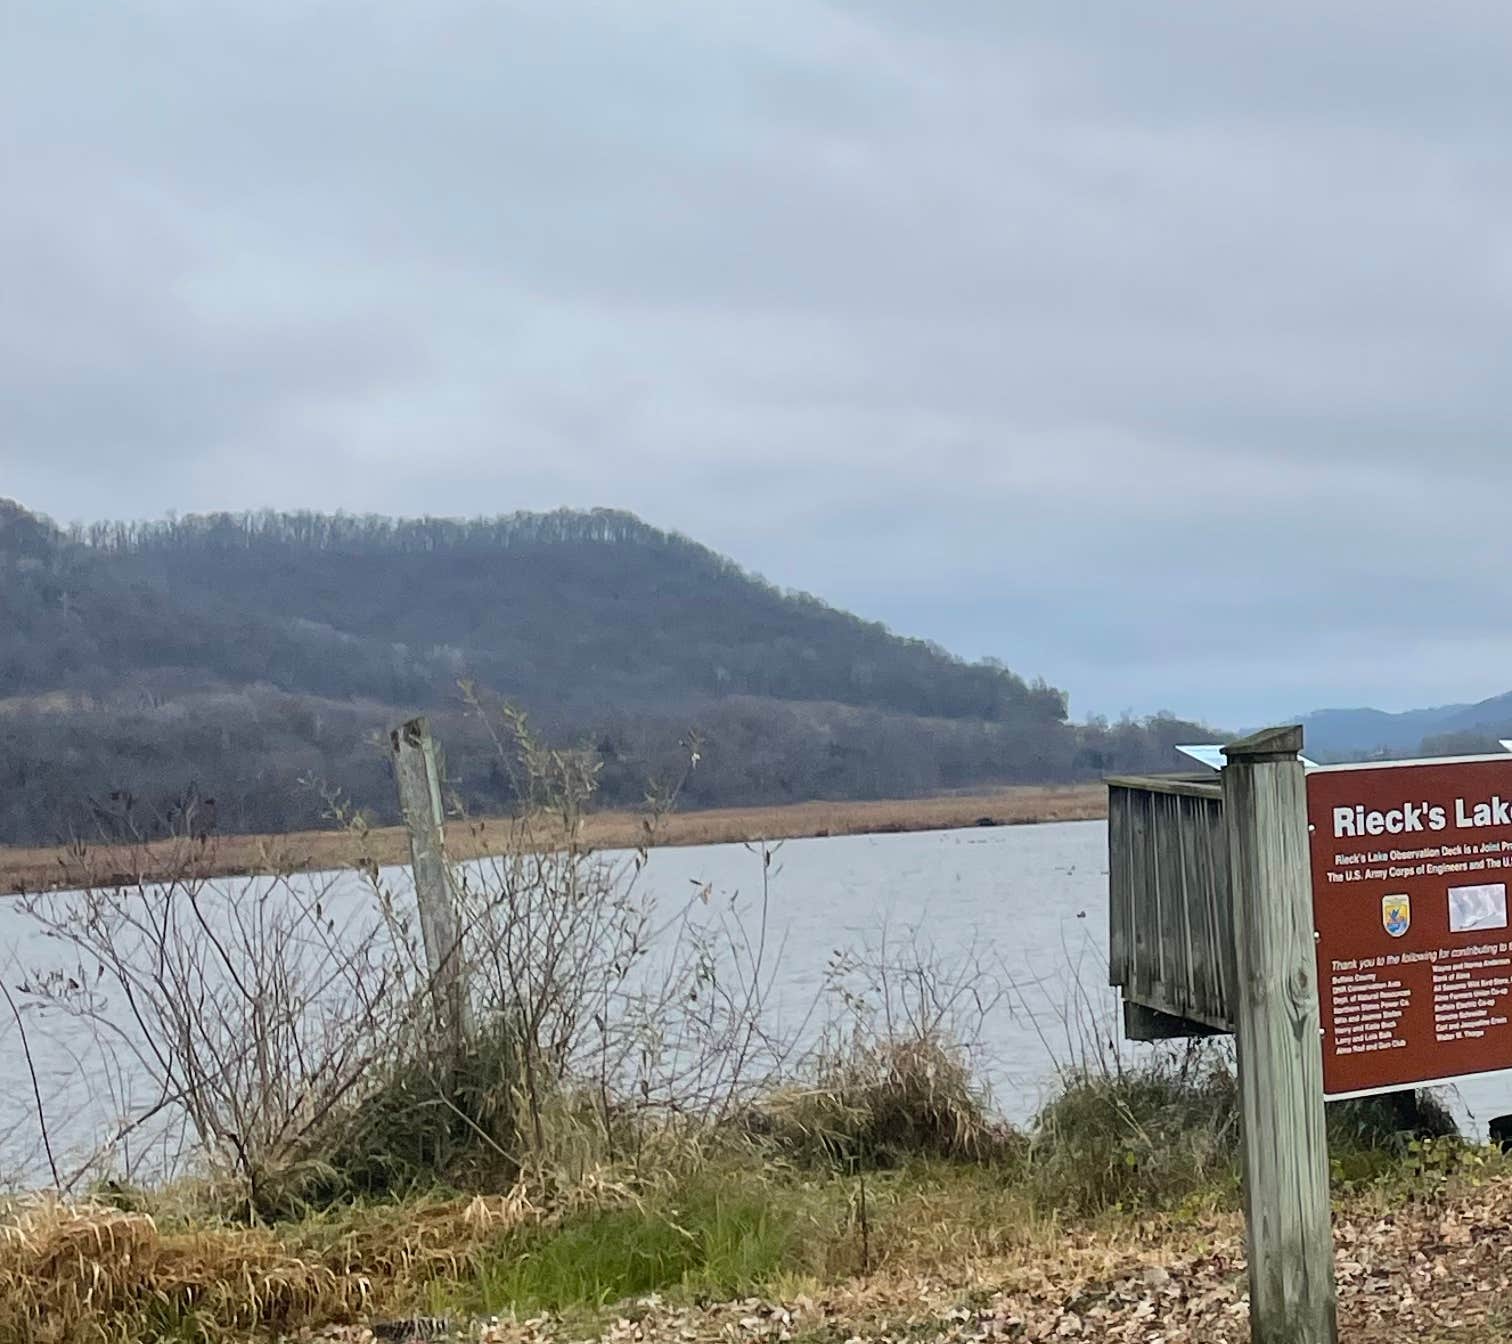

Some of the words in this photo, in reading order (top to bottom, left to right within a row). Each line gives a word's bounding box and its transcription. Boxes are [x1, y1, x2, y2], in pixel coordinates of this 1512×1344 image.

[1333, 802, 1446, 837] Rieck's
[1335, 853, 1366, 865] Rieck's
[1368, 852, 1388, 862] Lake
[1390, 848, 1440, 860] Observation
[1441, 845, 1462, 856] Deck
[1464, 844, 1471, 854] is
[1480, 843, 1500, 853] Joint
[1327, 872, 1344, 882] The
[1345, 870, 1363, 881] U.S.
[1365, 869, 1387, 880] Army
[1389, 867, 1415, 878] Corps
[1416, 864, 1425, 875] of
[1426, 862, 1468, 875] Engineers
[1469, 859, 1485, 870] and
[1486, 858, 1501, 868] The
[1332, 959, 1357, 971] Thank
[1359, 959, 1375, 970] you
[1377, 957, 1385, 966] to
[1387, 955, 1400, 964] the
[1401, 951, 1437, 963] following
[1439, 949, 1450, 959] for
[1499, 943, 1507, 952] to
